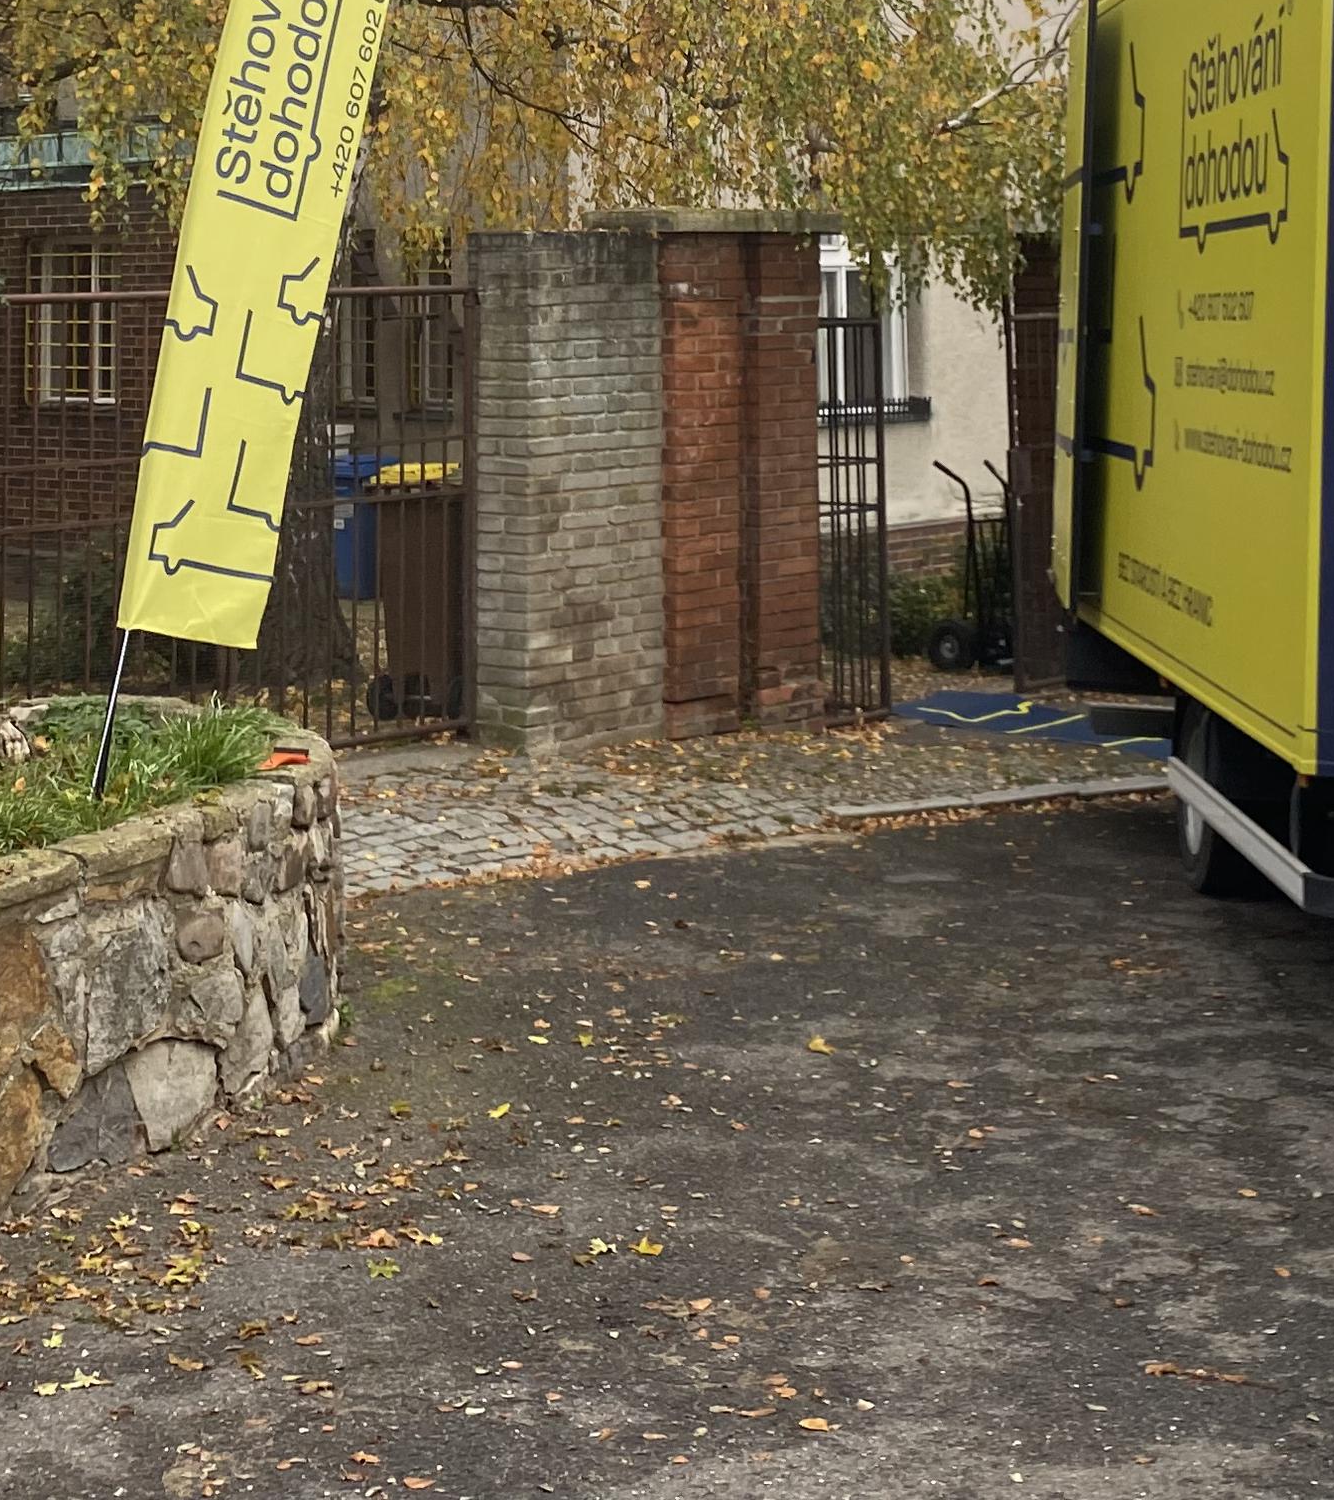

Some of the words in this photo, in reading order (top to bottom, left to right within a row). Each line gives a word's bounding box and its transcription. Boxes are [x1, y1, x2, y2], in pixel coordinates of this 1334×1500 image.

[330, 125, 354, 198] +420
[346, 66, 368, 119] 607
[359, 9, 382, 63] 602
[1187, 3, 1285, 120] Stěhování
[1184, 118, 1269, 210] dohodou
